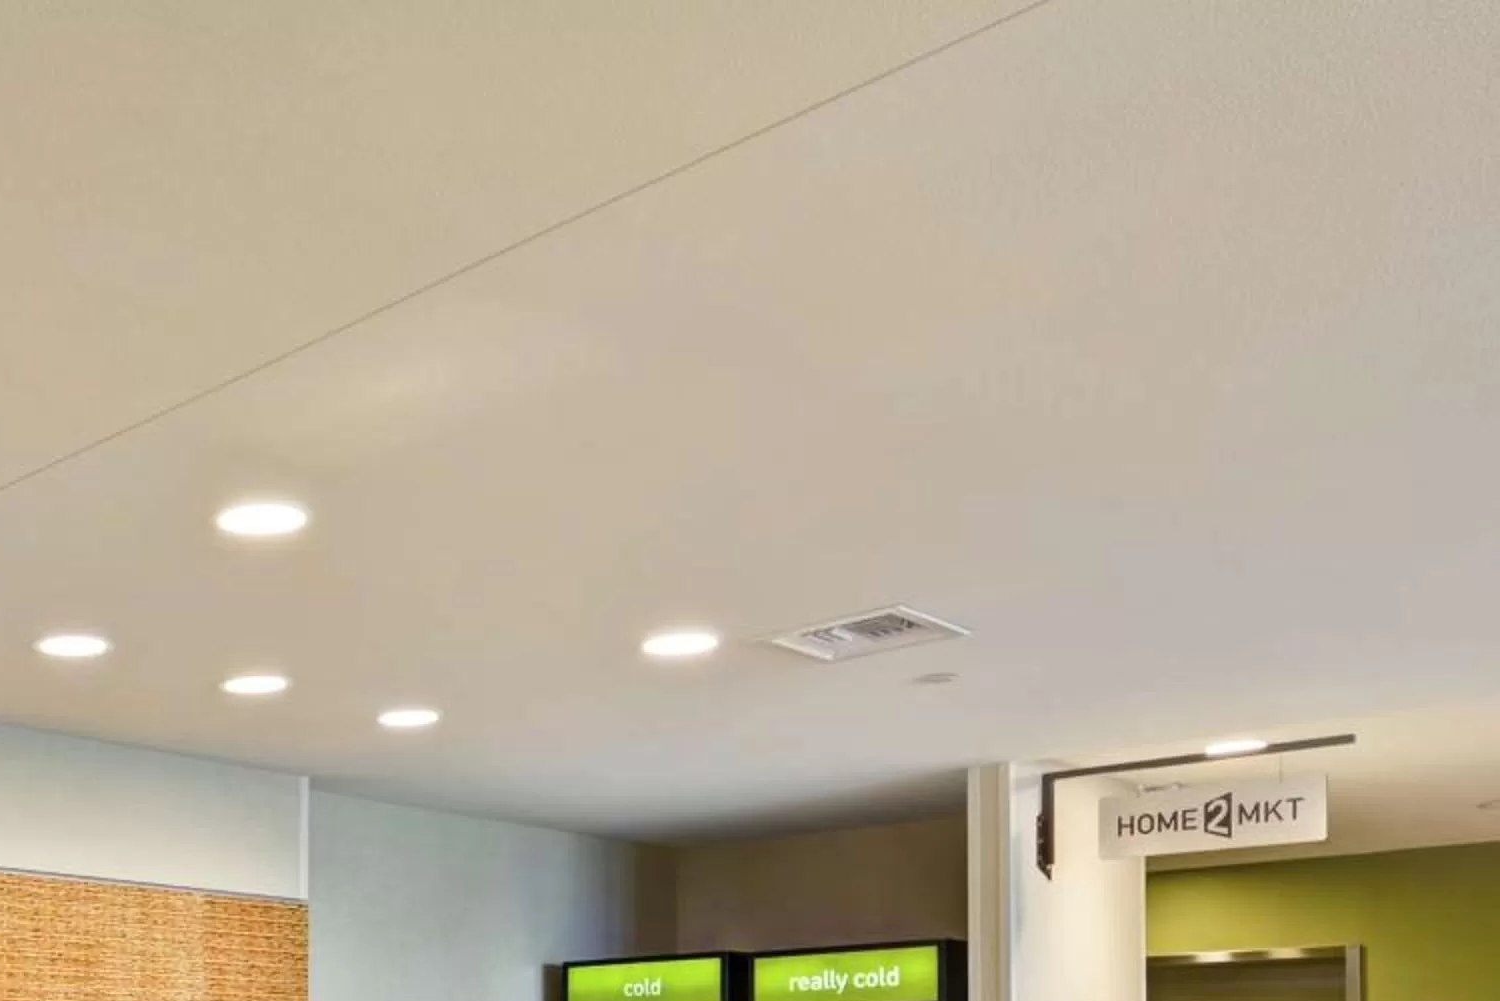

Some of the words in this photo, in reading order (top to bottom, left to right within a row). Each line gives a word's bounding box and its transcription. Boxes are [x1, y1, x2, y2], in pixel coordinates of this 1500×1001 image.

[1237, 797, 1305, 825] MKT
[623, 977, 662, 997] cold
[789, 969, 848, 995] really
[853, 966, 900, 989] cold
